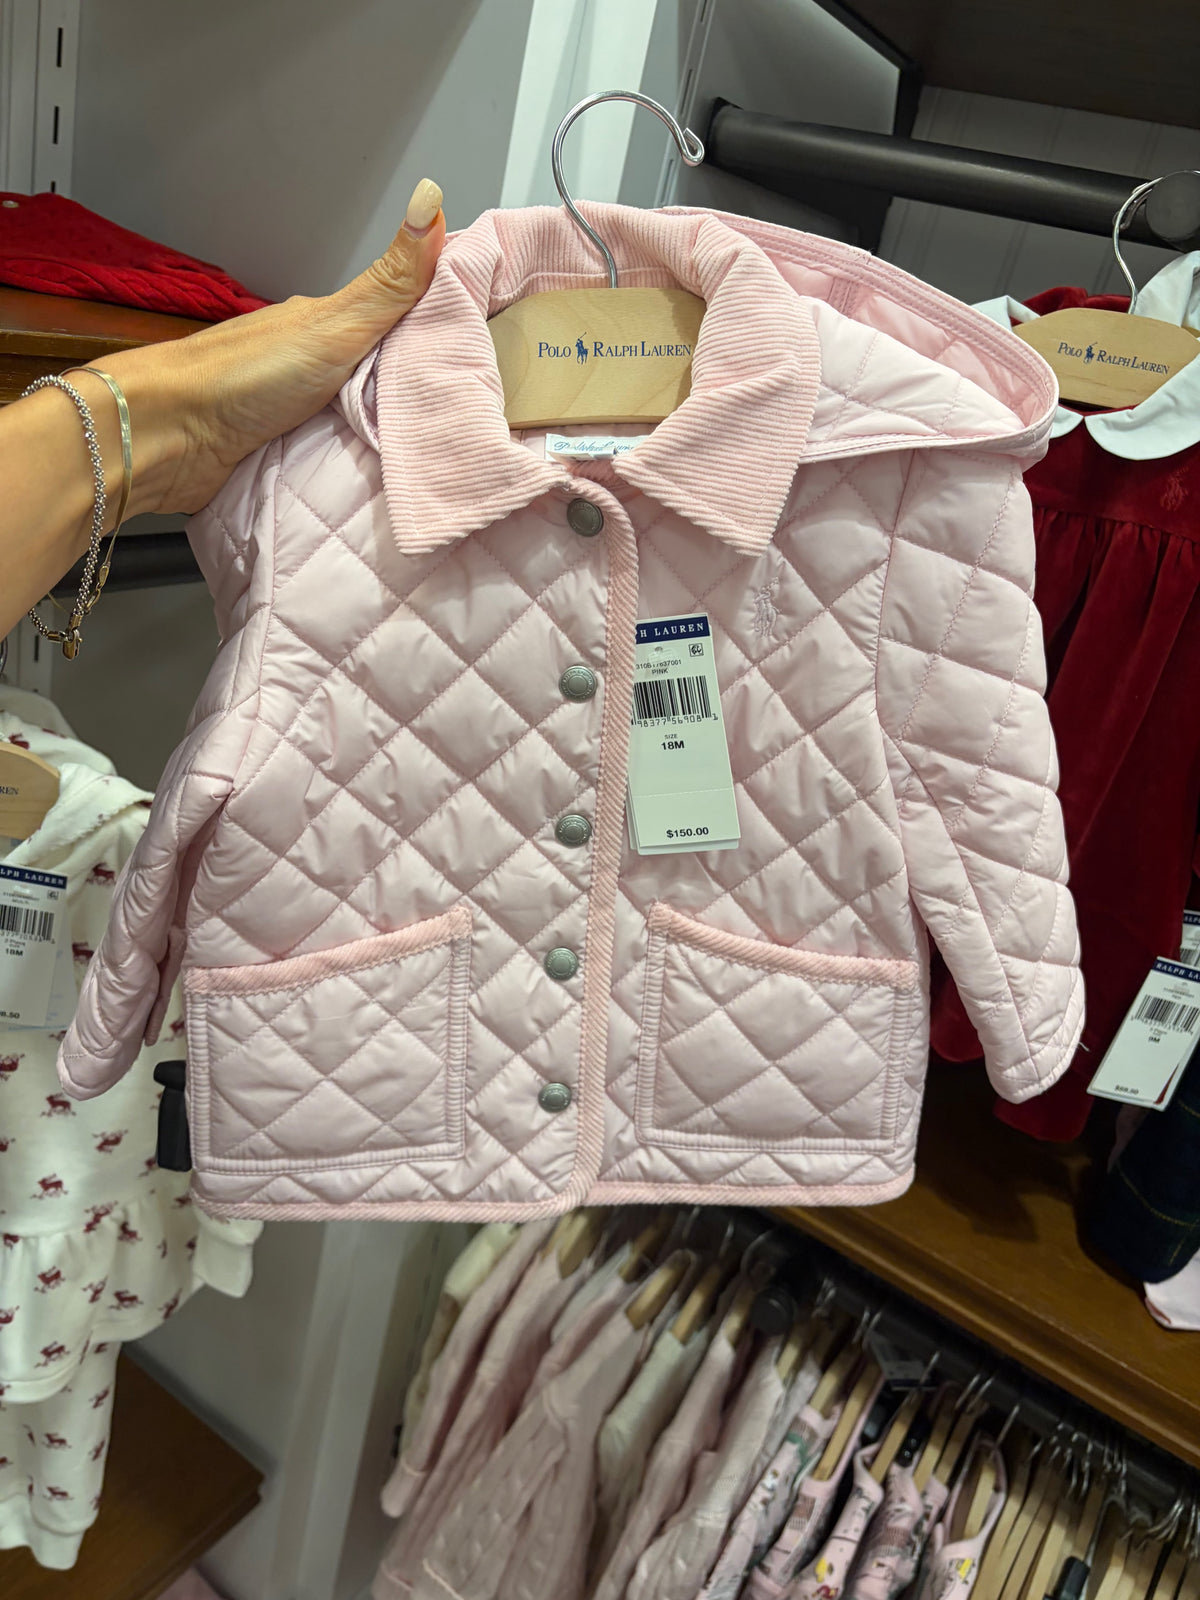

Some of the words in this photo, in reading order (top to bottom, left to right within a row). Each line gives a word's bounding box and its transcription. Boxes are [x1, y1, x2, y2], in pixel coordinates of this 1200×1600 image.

[537, 342, 572, 358] POLO
[593, 341, 638, 358] RALPH
[641, 340, 692, 357] LAUREN
[1057, 341, 1083, 358] POLO
[1096, 349, 1131, 367] RALPH
[1130, 356, 1171, 375] LAUREN
[654, 622, 704, 637] LAUREN
[637, 717, 667, 728] 98377
[671, 714, 702, 725] 56908
[711, 712, 719, 721] 1
[660, 740, 685, 750] 18M
[666, 826, 709, 838] $150.00
[25, 872, 64, 886] LAUREN
[1156, 962, 1185, 976] RALPH
